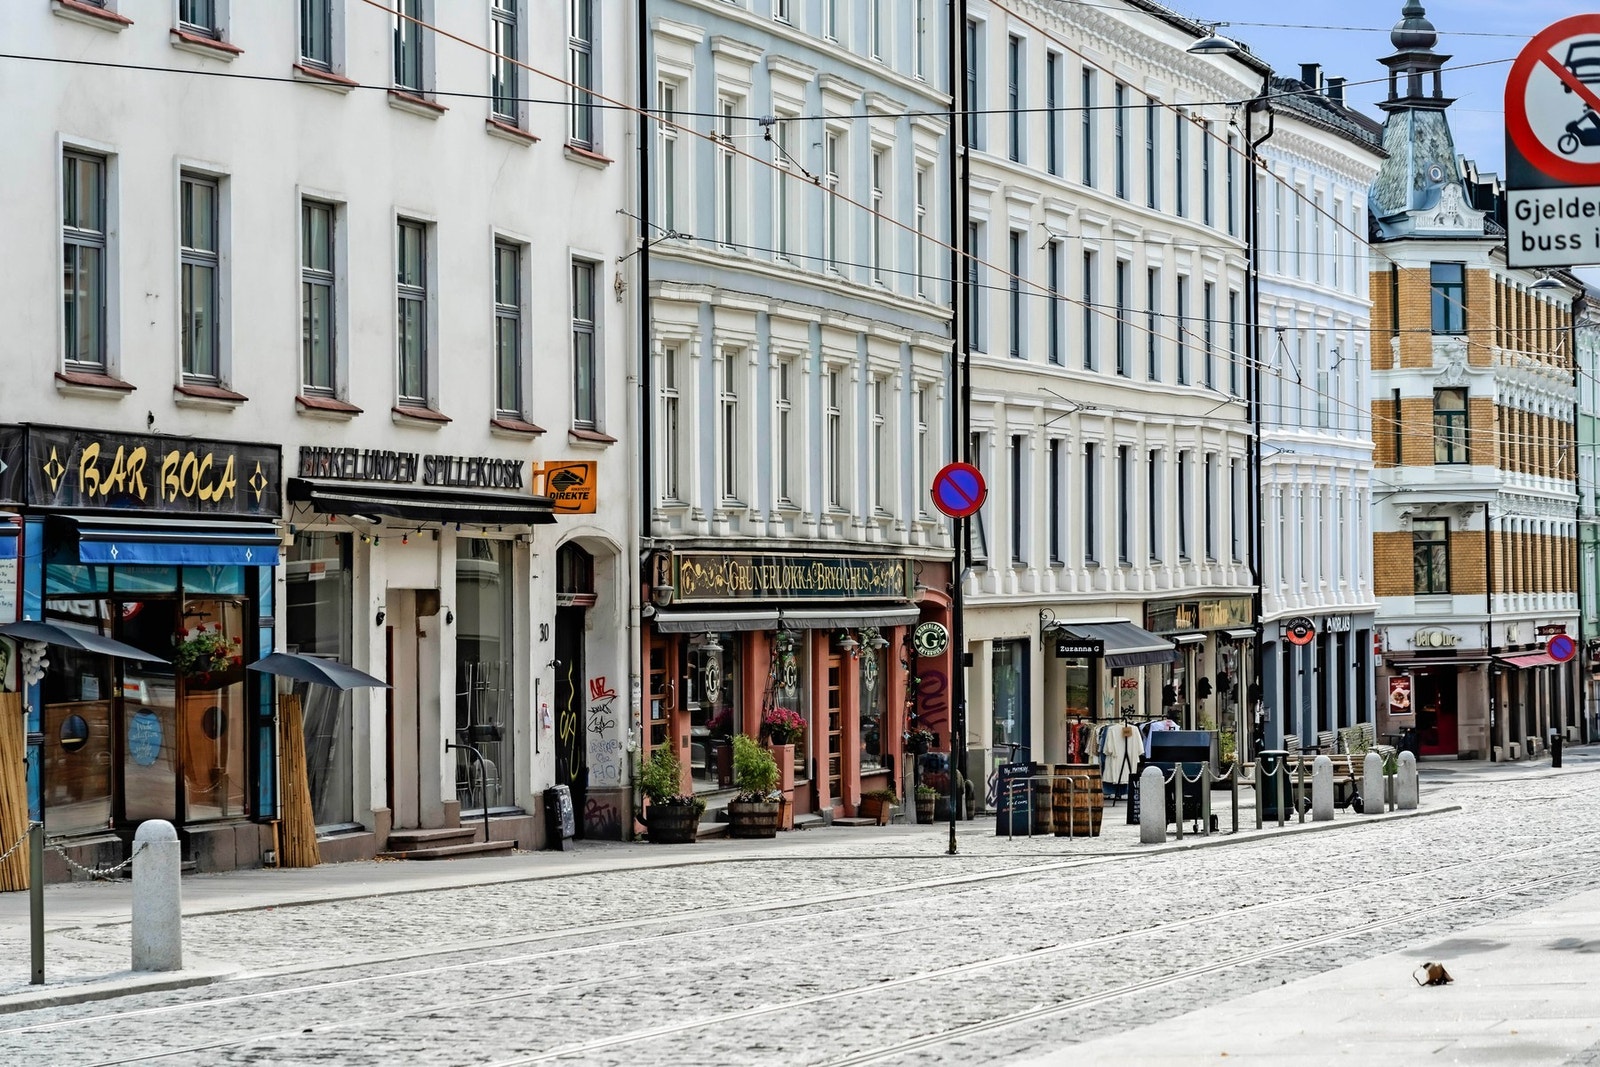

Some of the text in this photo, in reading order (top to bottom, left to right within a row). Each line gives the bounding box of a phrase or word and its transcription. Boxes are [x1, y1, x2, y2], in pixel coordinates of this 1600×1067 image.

[1522, 231, 1582, 252] buss
[79, 442, 237, 503] BAR BOCA
[298, 445, 525, 489] BIRKELUNDEN SPILLEKIOSK
[550, 492, 590, 500] DIREKTE
[817, 562, 869, 591] BRYGGHUS
[539, 622, 550, 642] 30
[921, 631, 939, 649] G
